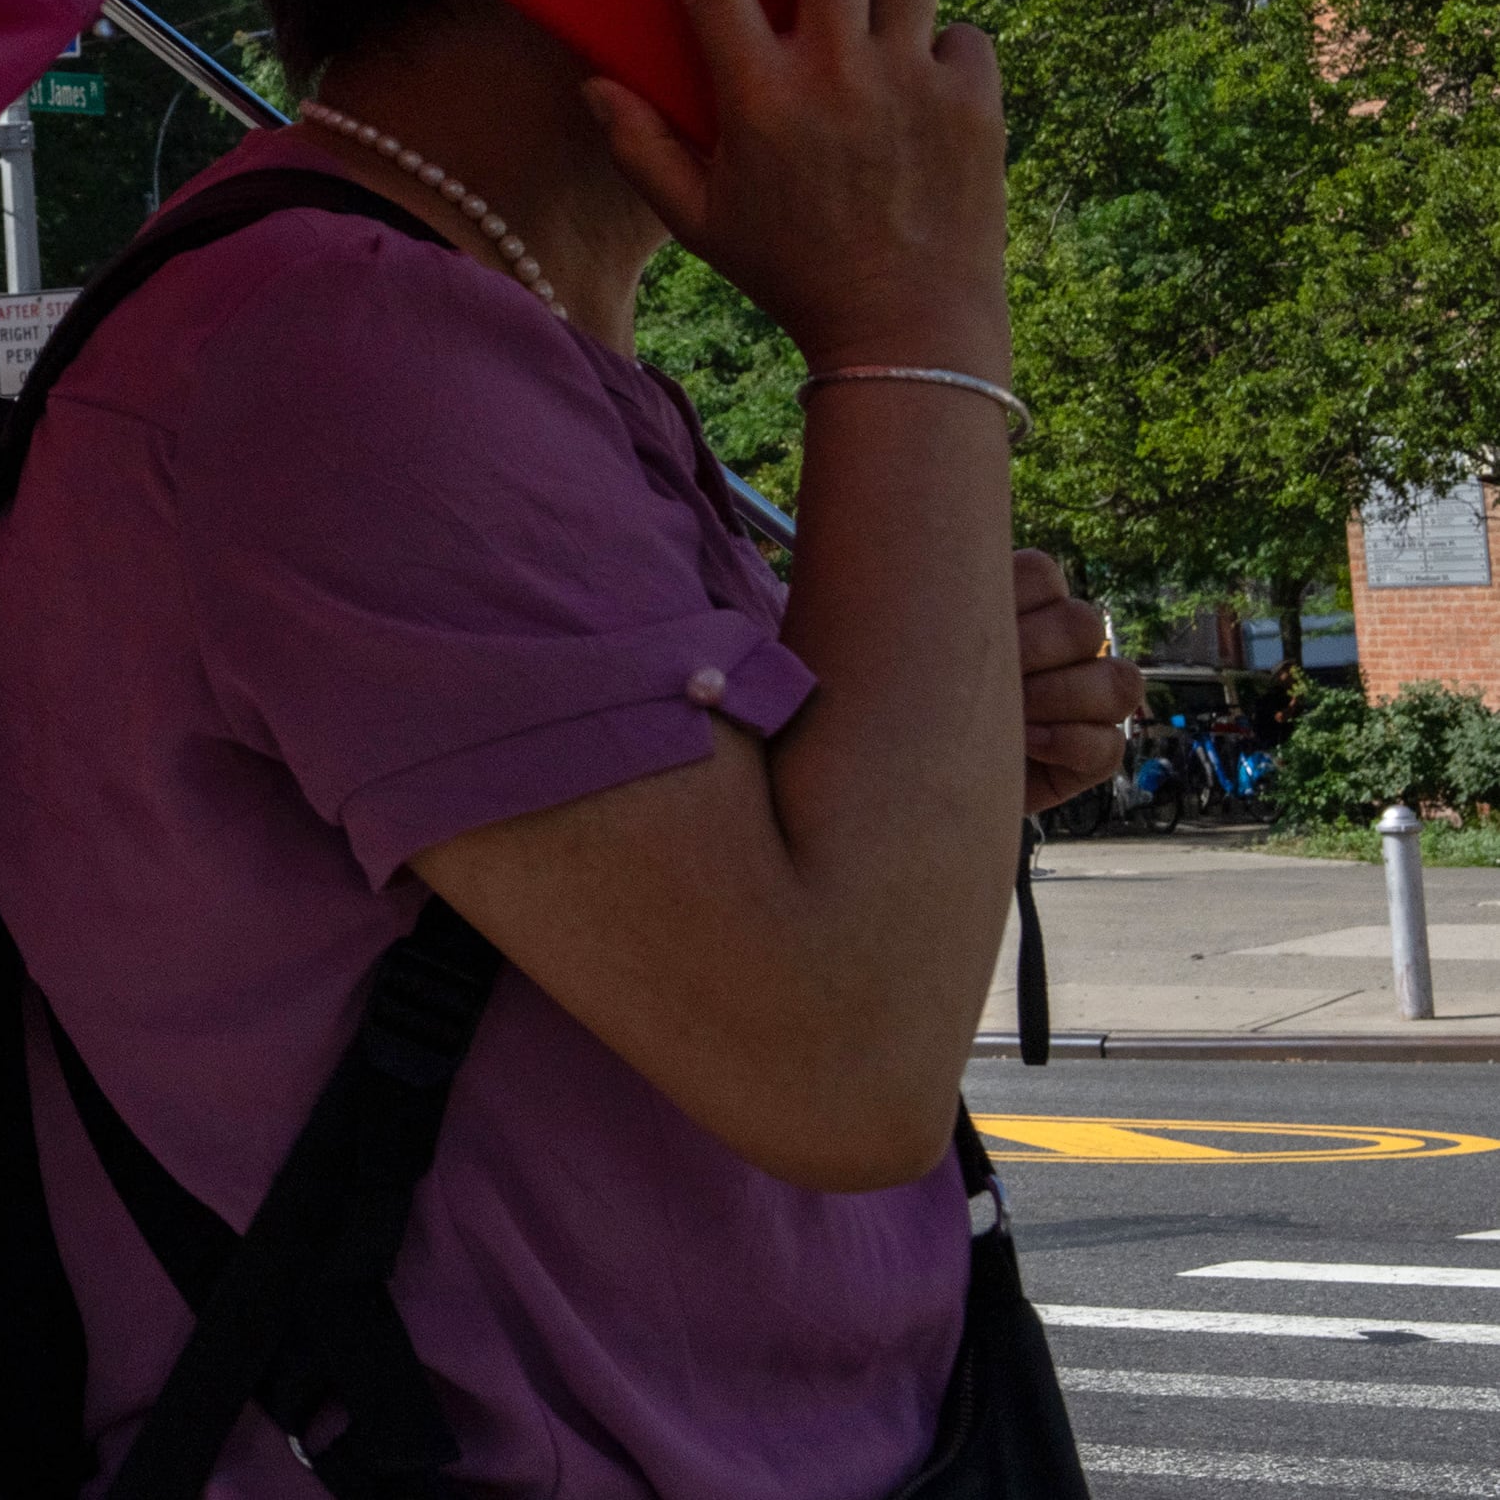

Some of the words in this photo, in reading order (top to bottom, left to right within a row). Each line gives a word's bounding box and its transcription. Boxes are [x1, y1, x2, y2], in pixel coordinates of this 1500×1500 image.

[31, 80, 43, 105] St
[48, 78, 86, 108] James
[0, 326, 40, 341] RIGHT
